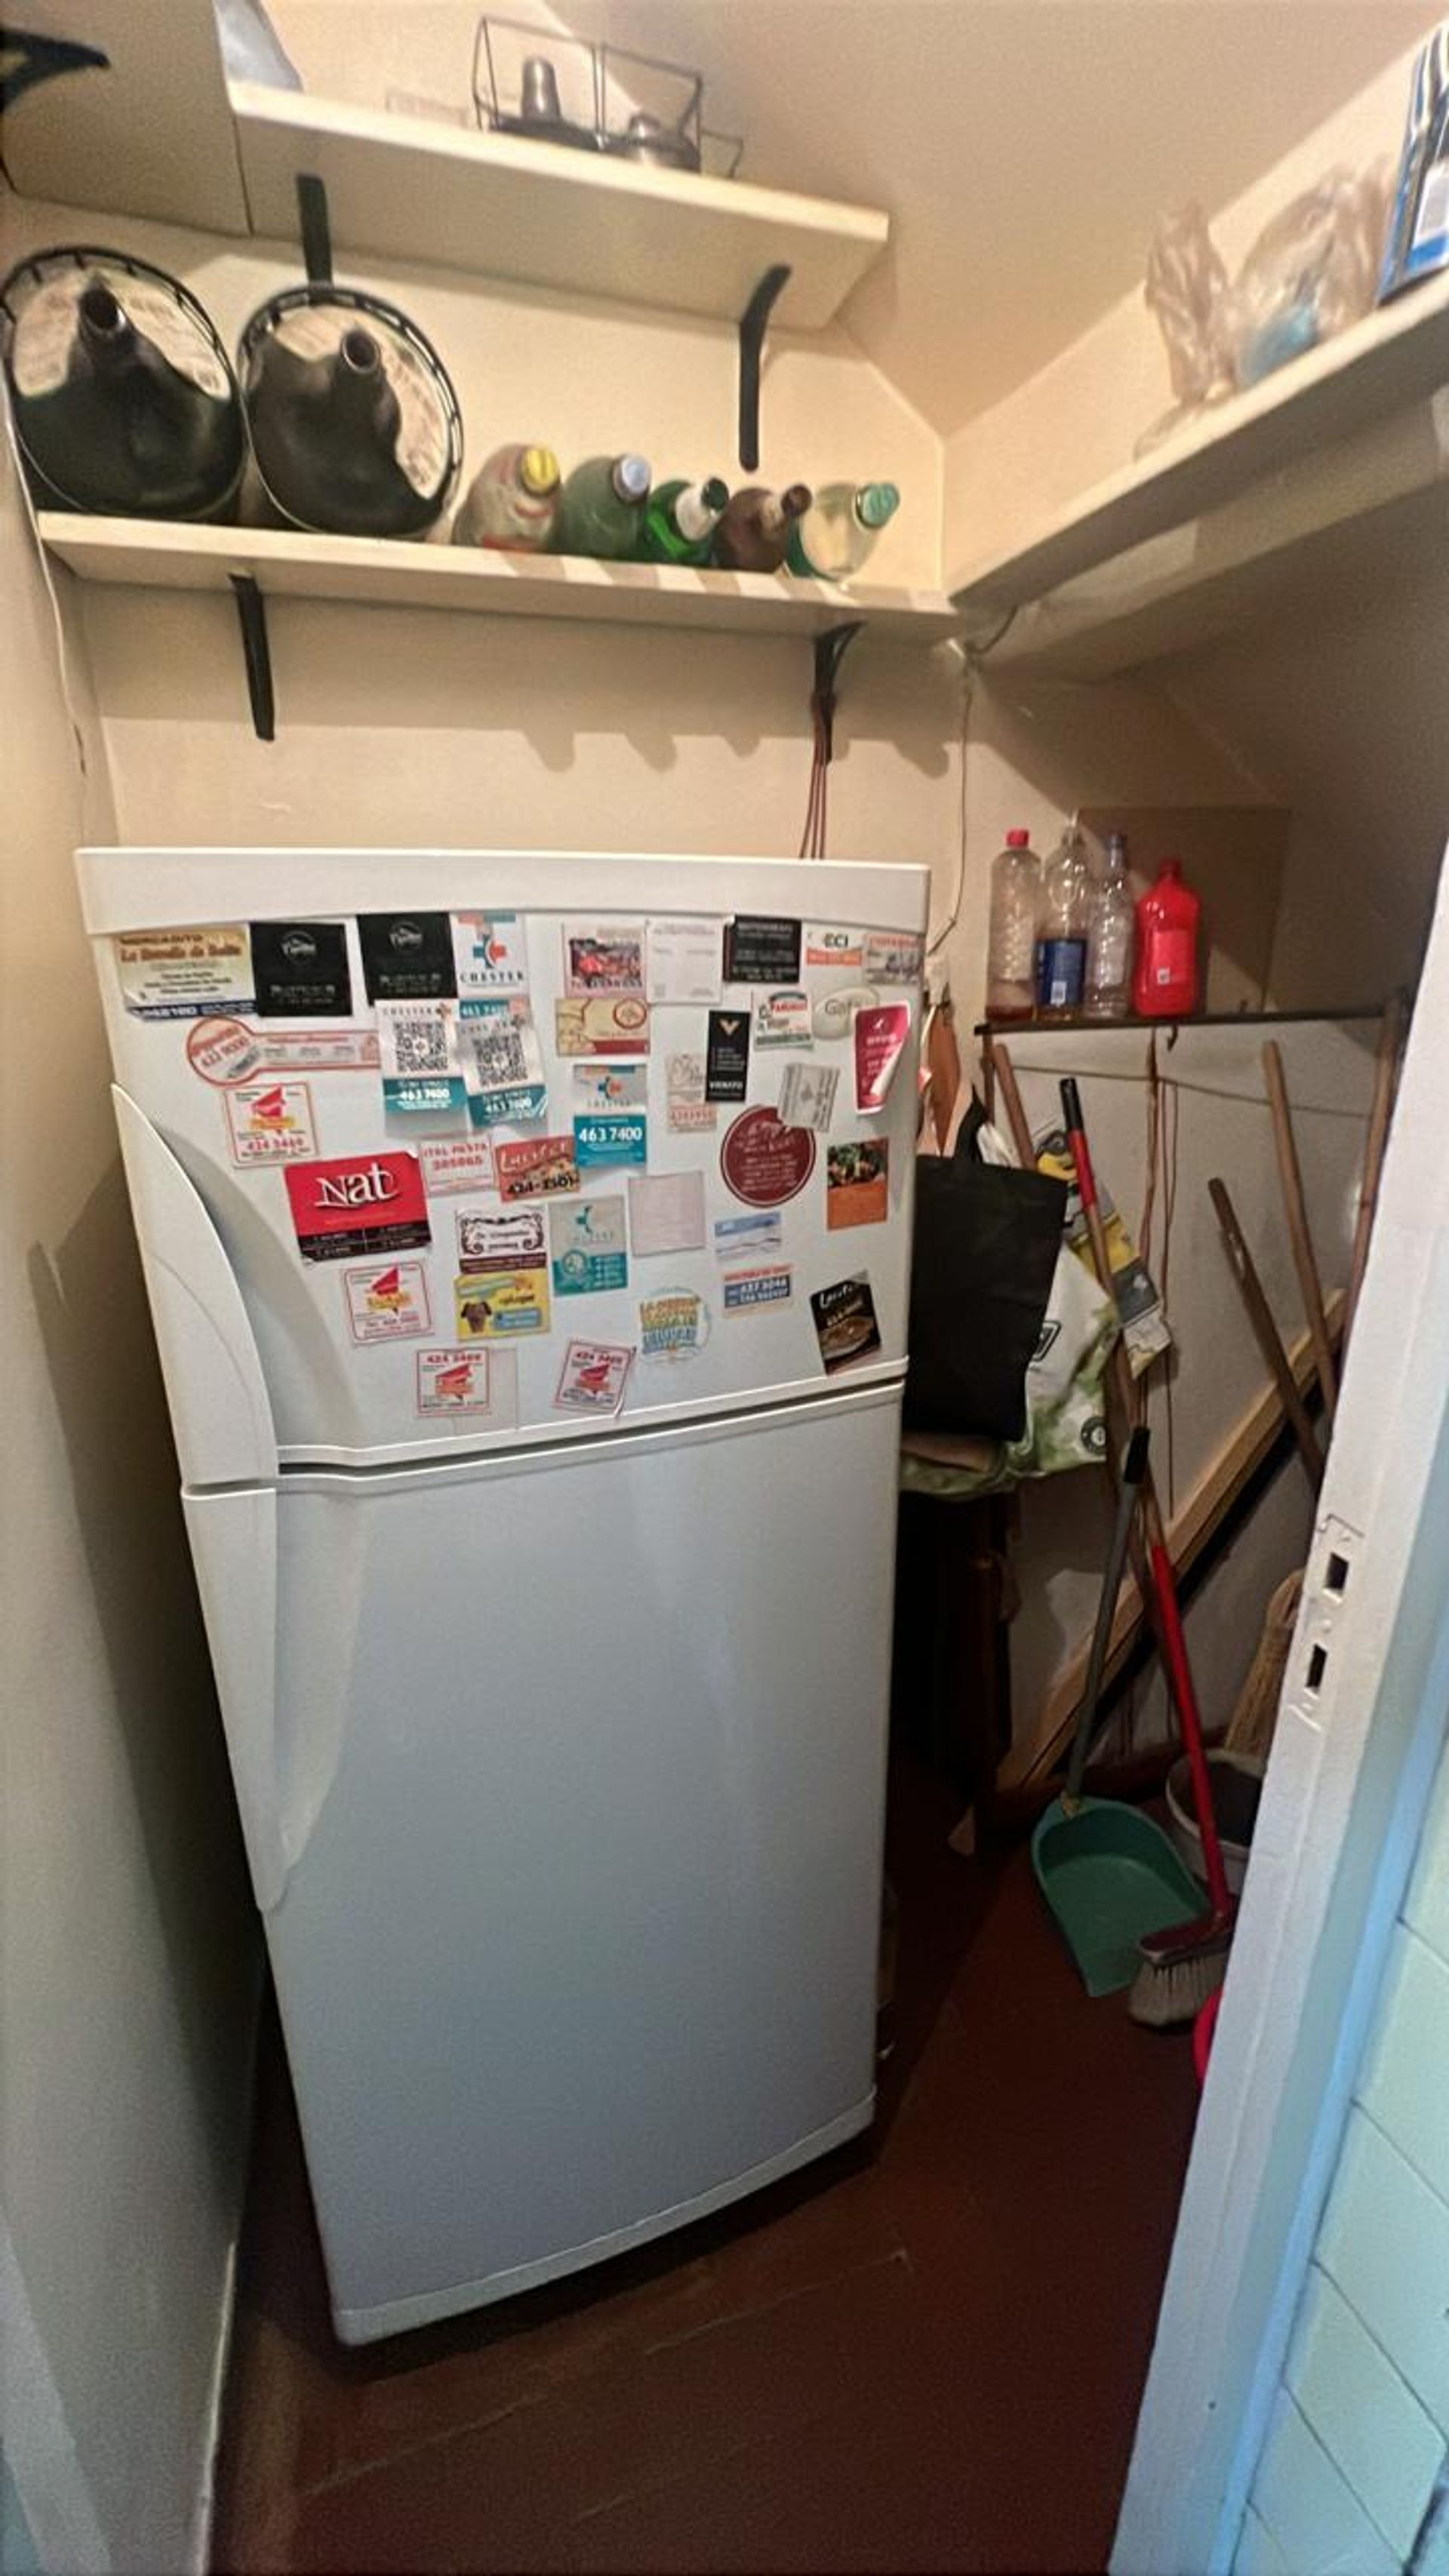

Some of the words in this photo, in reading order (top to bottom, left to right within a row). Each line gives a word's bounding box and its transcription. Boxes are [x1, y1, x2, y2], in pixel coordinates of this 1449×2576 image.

[460, 971, 525, 983] CHESTER
[579, 1128, 607, 1143] 463
[608, 1126, 643, 1140] 7400
[314, 1161, 401, 1208] Nat
